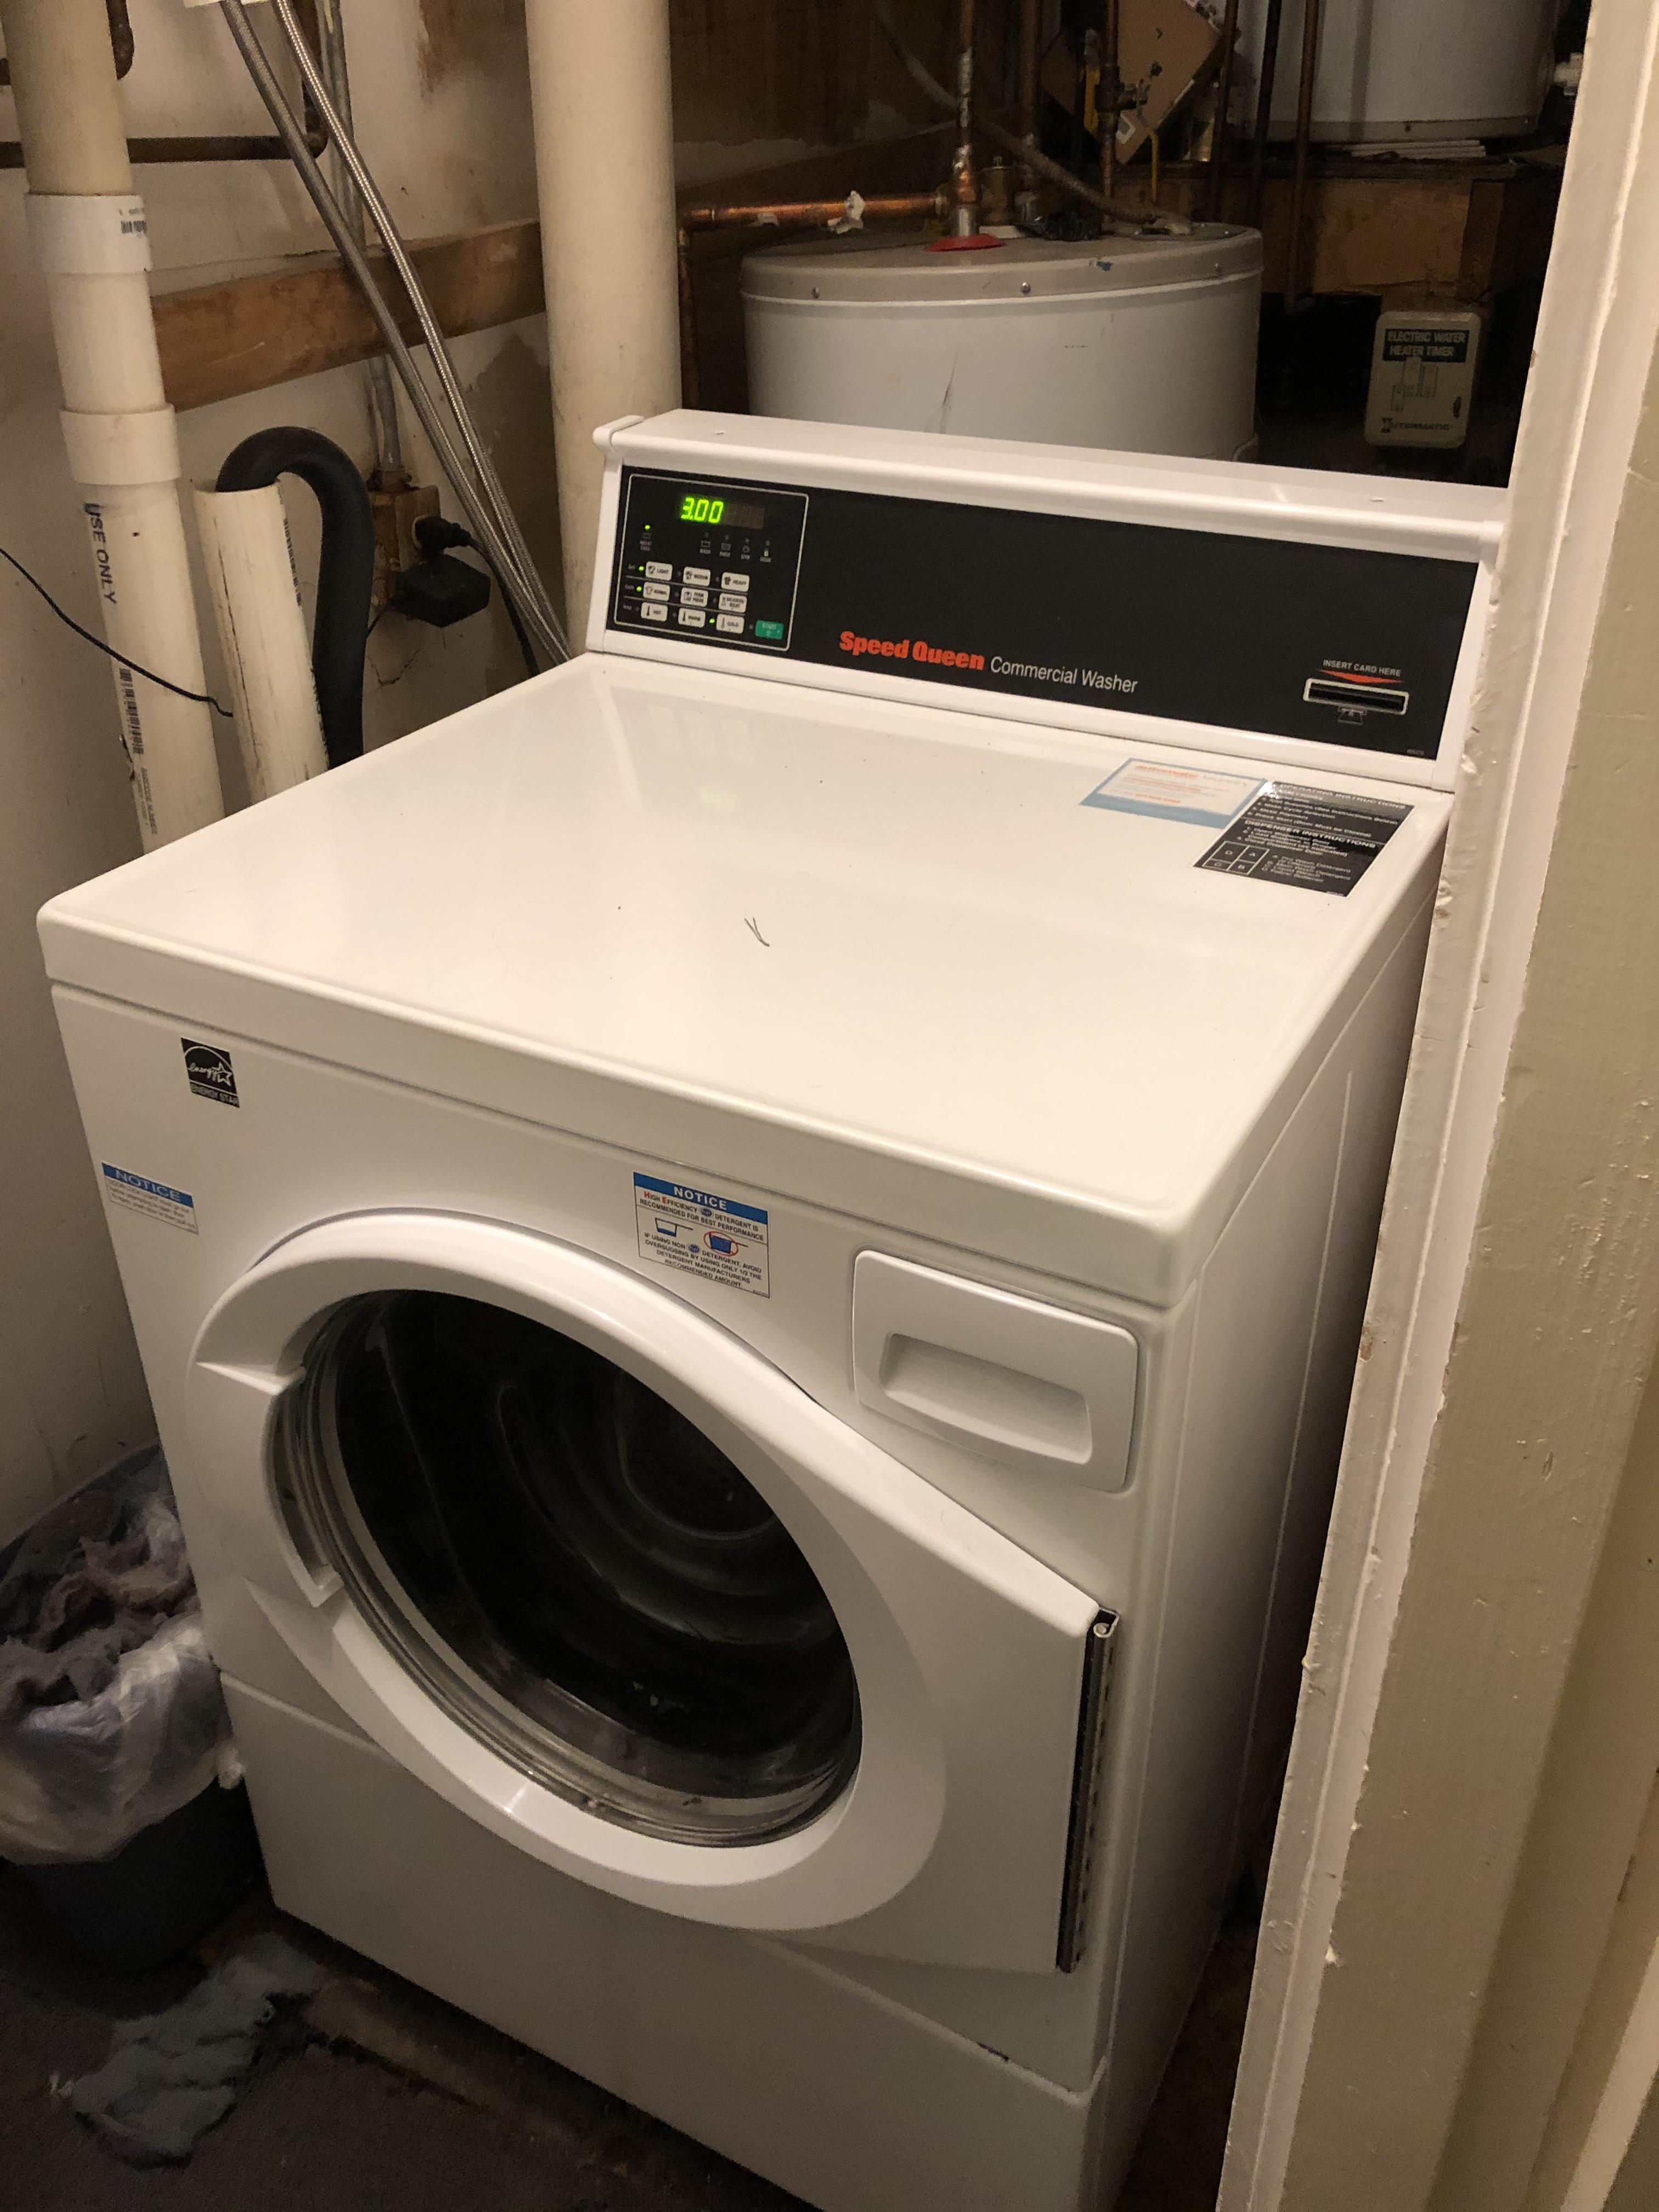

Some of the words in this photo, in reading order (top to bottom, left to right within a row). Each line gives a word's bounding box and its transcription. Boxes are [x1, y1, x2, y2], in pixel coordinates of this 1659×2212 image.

[1387, 331, 1431, 342] ELECTRIC
[1433, 332, 1466, 343] WATER
[1389, 345, 1424, 356] HEATER
[1426, 346, 1454, 357] TIMER
[84, 503, 106, 543] USE
[97, 549, 117, 604] ONLY
[840, 631, 909, 659] Speed
[912, 641, 985, 670] Queen
[990, 656, 1077, 684] Commercial
[1081, 669, 1138, 693] Washer
[1323, 659, 1352, 670] INSERT
[1354, 663, 1377, 673] CARD
[1379, 668, 1401, 677] HERE
[1334, 793, 1406, 809] INSTRUCTIONS
[1243, 820, 1301, 834] DISPENSER
[1300, 831, 1376, 848] INSTRUCTIONS
[115, 1169, 182, 1202] NOTICE
[673, 1185, 727, 1211] NOTICE
[640, 1198, 685, 1217] RECOMMENDED
[686, 1212, 698, 1221] FOR
[701, 1216, 715, 1226] BEST
[717, 1221, 764, 1242] PERFORMANCE
[662, 1196, 697, 1212] EFFICIENCY
[714, 1212, 751, 1229] DETERGENT
[651, 1234, 670, 1244] USING
[672, 1240, 685, 1249] NON
[742, 1262, 761, 1273] AVOID
[656, 1249, 693, 1266] DETERGENT
[695, 1261, 750, 1284] MANUFACTURERS
[664, 1258, 713, 1279] RECOMMENDED
[700, 1256, 720, 1267] USING
[721, 1263, 737, 1273] ONLY
[749, 1272, 761, 1280] THE
